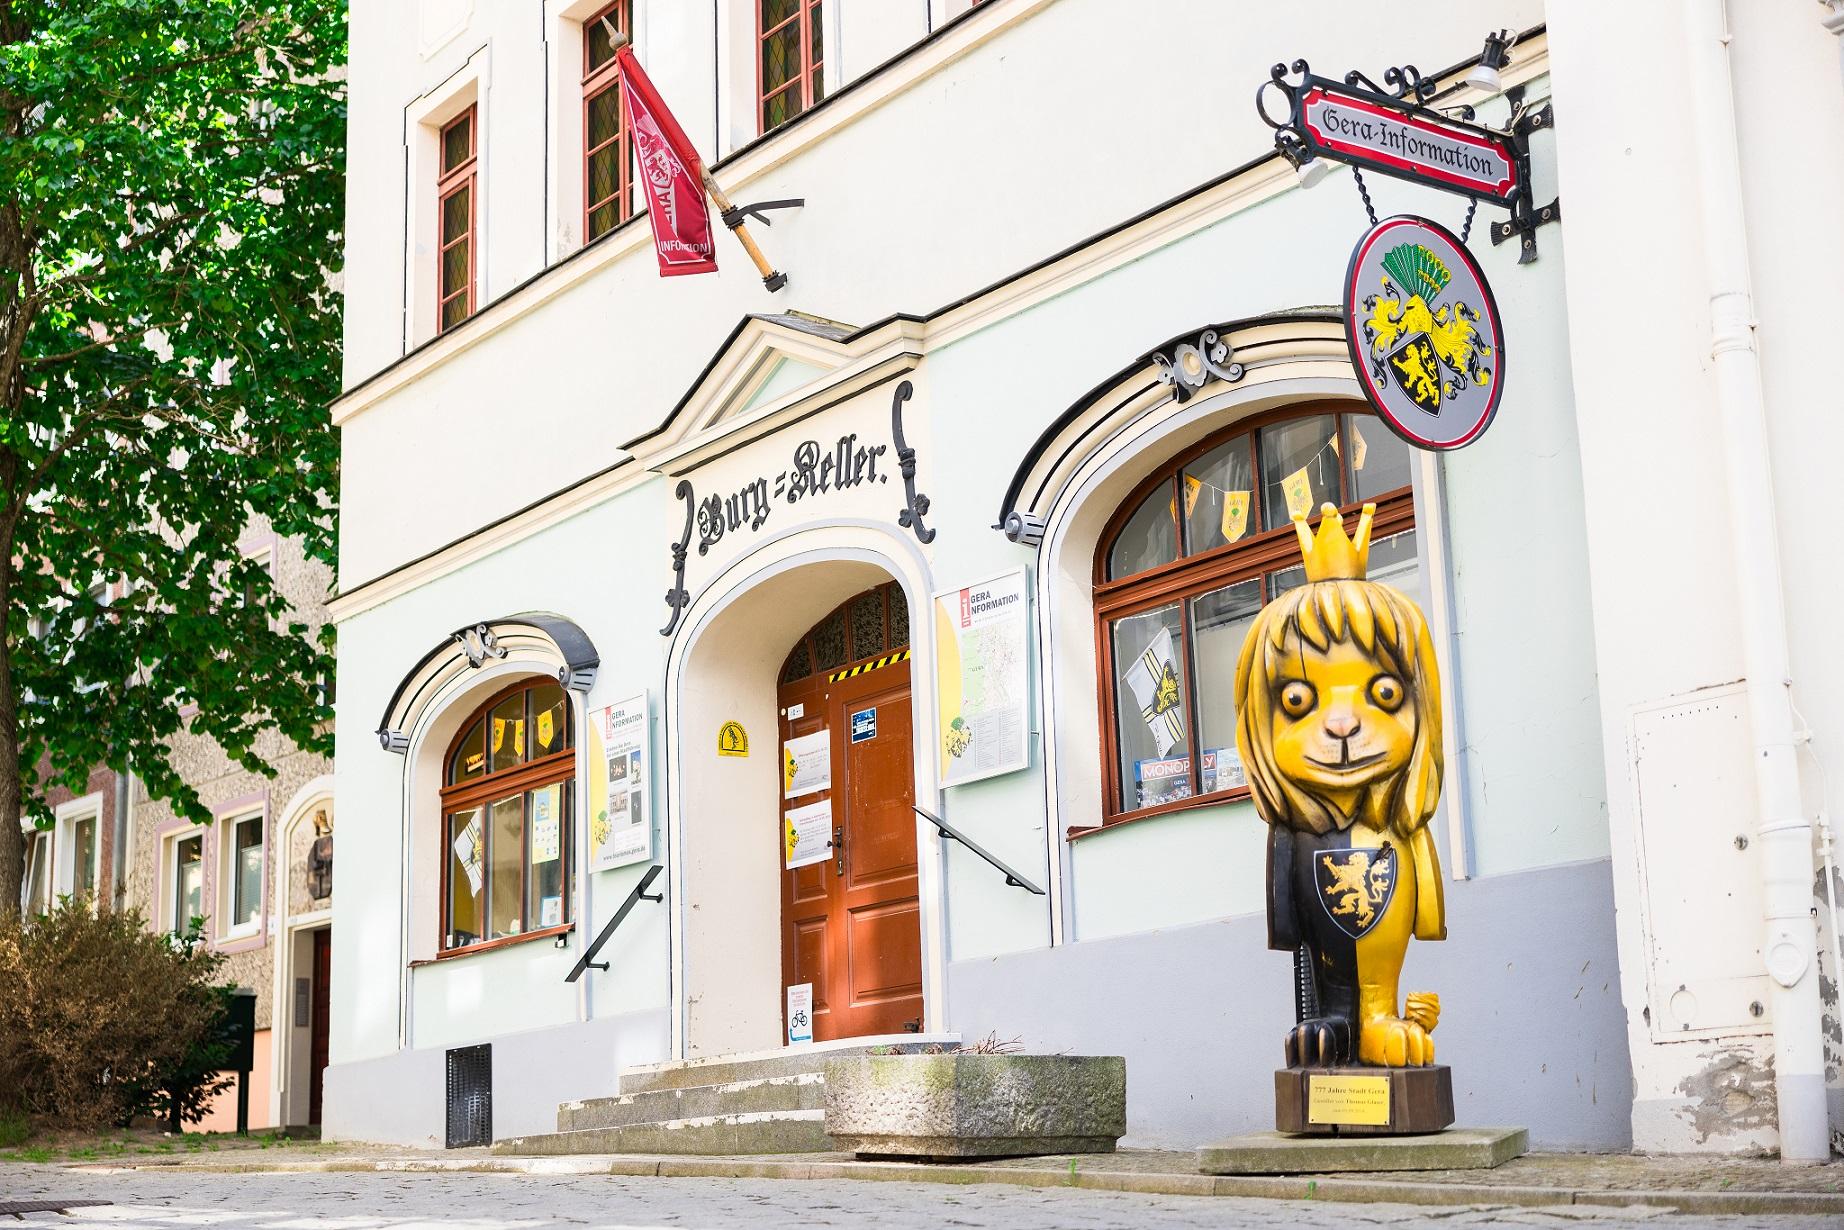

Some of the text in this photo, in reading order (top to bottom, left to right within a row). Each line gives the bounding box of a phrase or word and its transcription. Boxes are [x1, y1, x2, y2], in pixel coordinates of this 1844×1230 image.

[1322, 105, 1494, 176] Gera-Information
[970, 590, 991, 604] GERA
[612, 709, 626, 720] GERA
